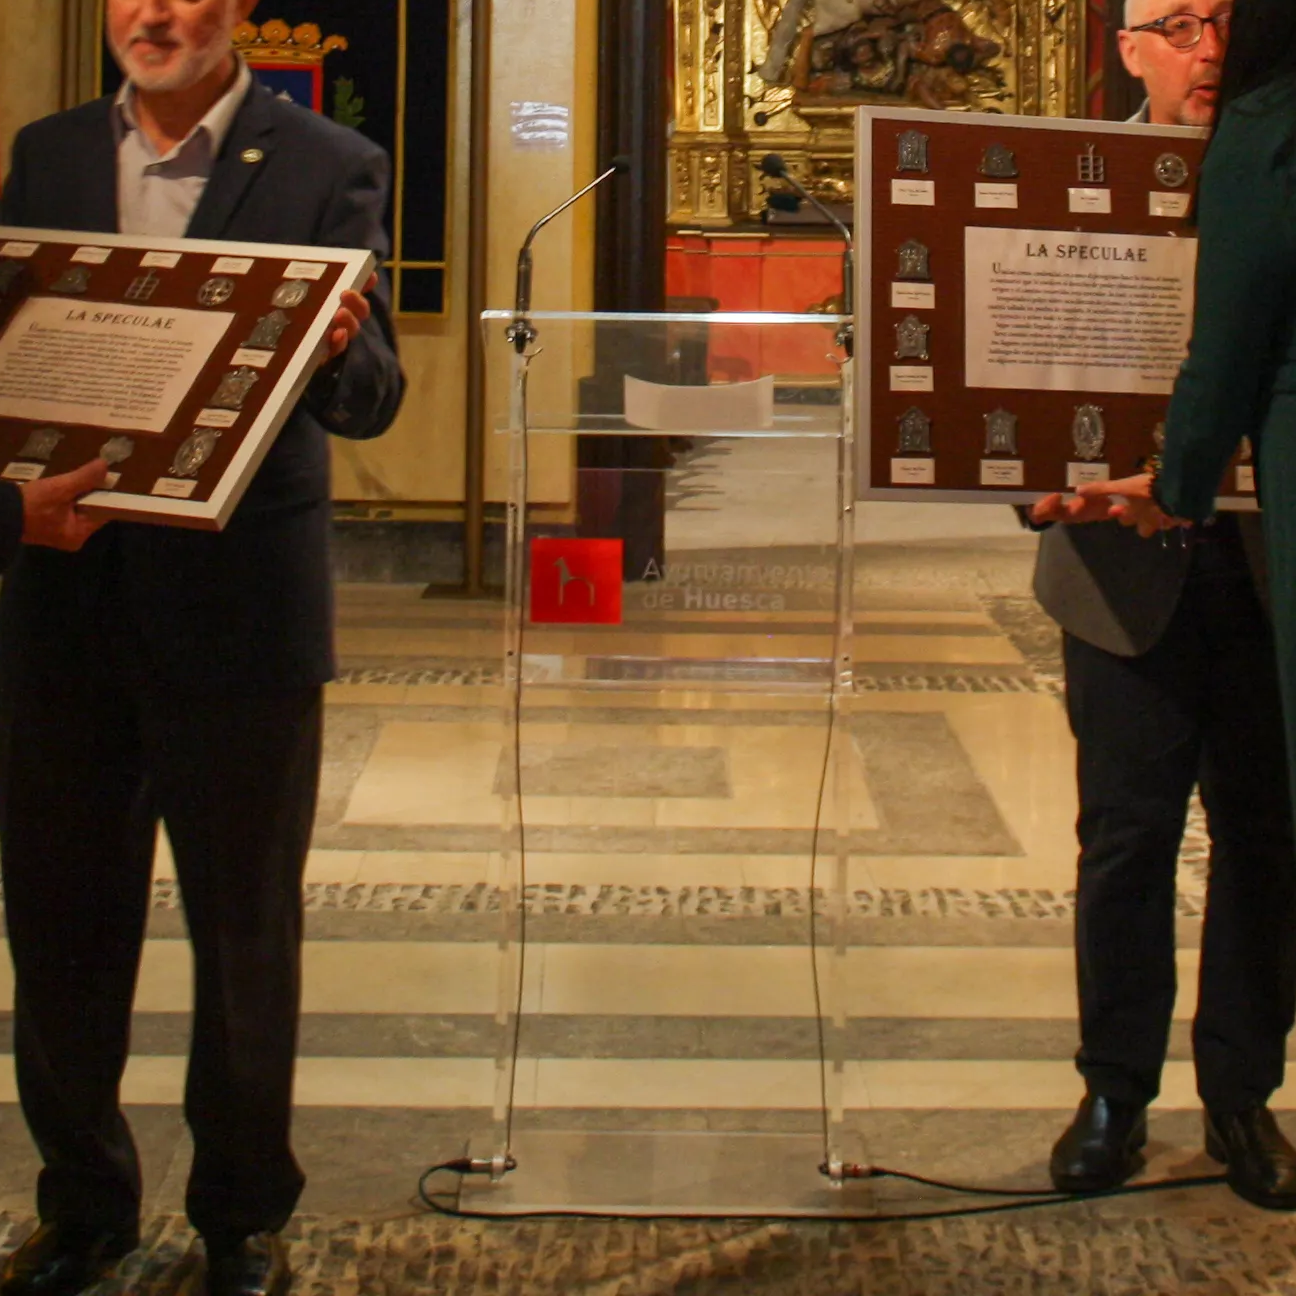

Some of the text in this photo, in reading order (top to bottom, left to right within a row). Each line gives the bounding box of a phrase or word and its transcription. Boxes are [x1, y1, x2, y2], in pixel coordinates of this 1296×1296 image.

[1025, 242, 1148, 262] LA SPECULAE
[66, 308, 176, 330] LA SPECULAE
[642, 587, 786, 611] de Huesca
